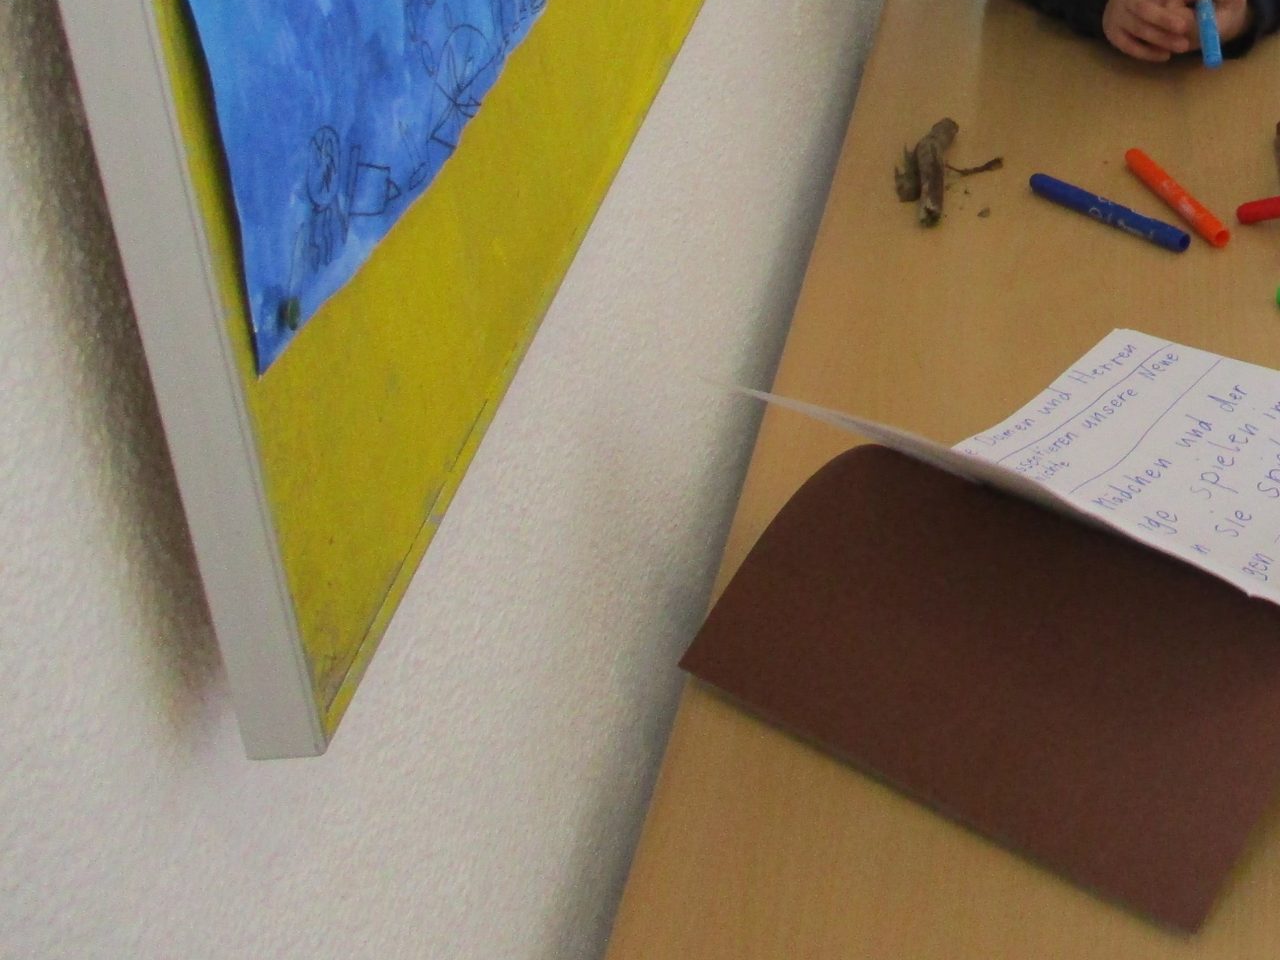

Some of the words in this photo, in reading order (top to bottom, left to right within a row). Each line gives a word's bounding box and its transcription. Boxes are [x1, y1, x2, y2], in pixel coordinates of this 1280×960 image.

[1038, 386, 1071, 415] und
[1067, 343, 1137, 384] Herren
[1082, 388, 1139, 430] unsere
[1175, 413, 1213, 449] und
[1208, 384, 1249, 413] der
[1190, 420, 1260, 499] spielen
